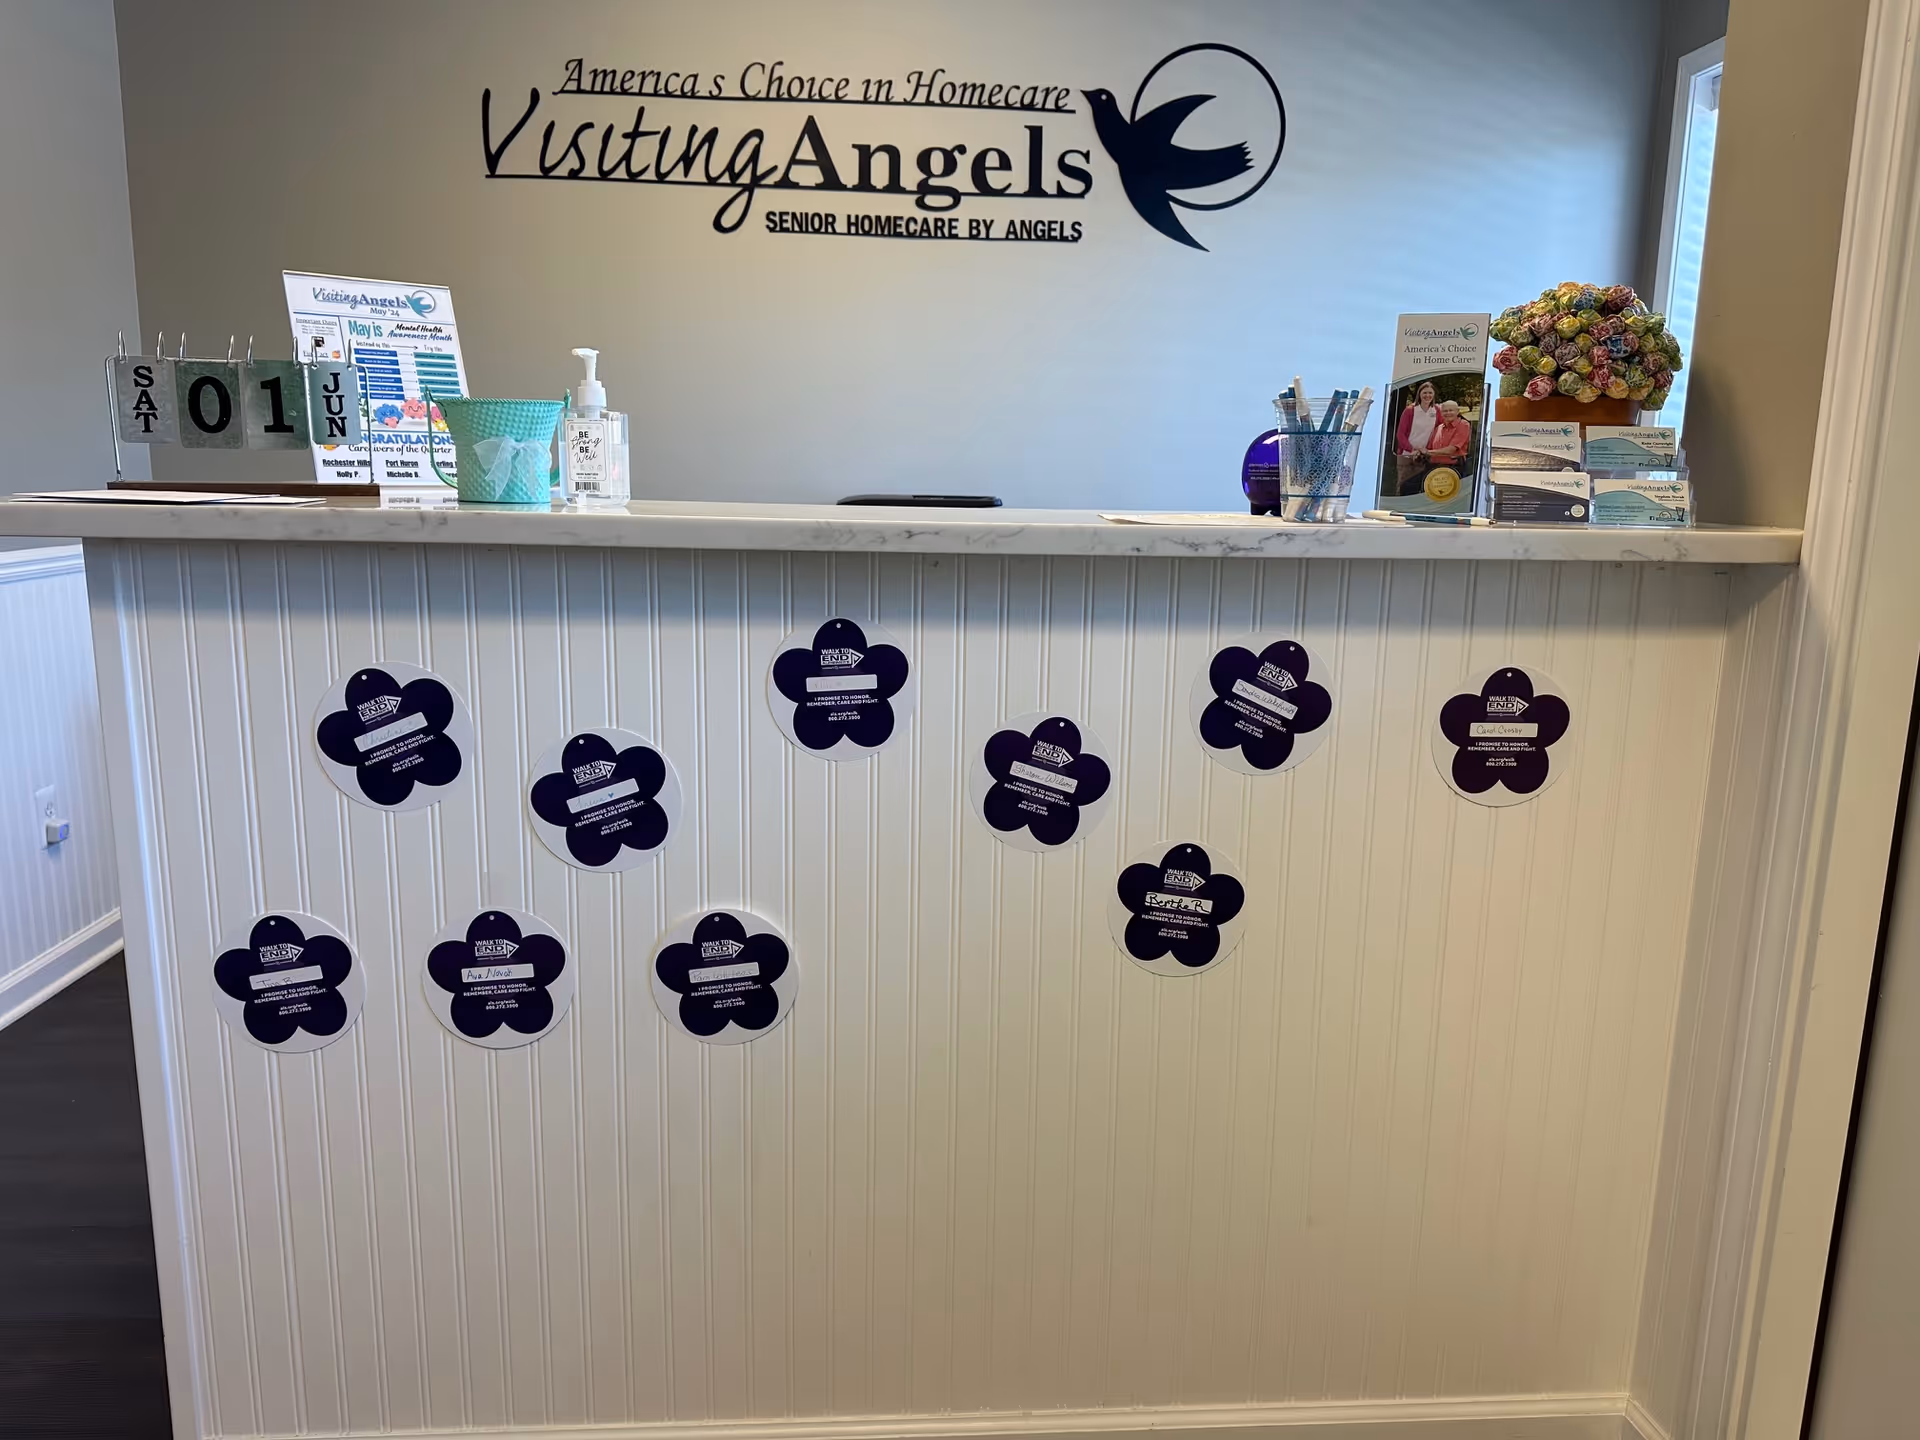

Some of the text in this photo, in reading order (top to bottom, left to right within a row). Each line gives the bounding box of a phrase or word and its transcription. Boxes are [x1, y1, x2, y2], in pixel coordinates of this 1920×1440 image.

[554, 58, 700, 97] America
[740, 60, 850, 100] Choice
[861, 76, 895, 101] in
[903, 68, 1071, 111] Homecare
[765, 210, 1083, 242] SENIOR HOMECARE BY ANGELS
[370, 307, 387, 317] May
[348, 320, 371, 339] May
[372, 321, 383, 337] is
[395, 323, 443, 334] Mental Health
[387, 330, 453, 342] Awareness Month
[1404, 344, 1477, 353] America's Choice
[1413, 356, 1421, 364] in
[1423, 356, 1450, 364] Home
[132, 365, 158, 433] SAT
[322, 372, 347, 438] JUN
[578, 431, 589, 439] BE
[396, 444, 404, 455] of
[406, 445, 418, 453] the
[322, 459, 355, 467] Rochester
[822, 654, 849, 662] END
[1264, 661, 1281, 673] WALK
[357, 699, 377, 711] WALK
[1037, 740, 1054, 750] WALK
[572, 763, 592, 774] WALK
[1166, 875, 1191, 883] END
[260, 944, 279, 952] WALK
[476, 945, 504, 953] END
[703, 946, 730, 954] END
[261, 949, 290, 959] END
